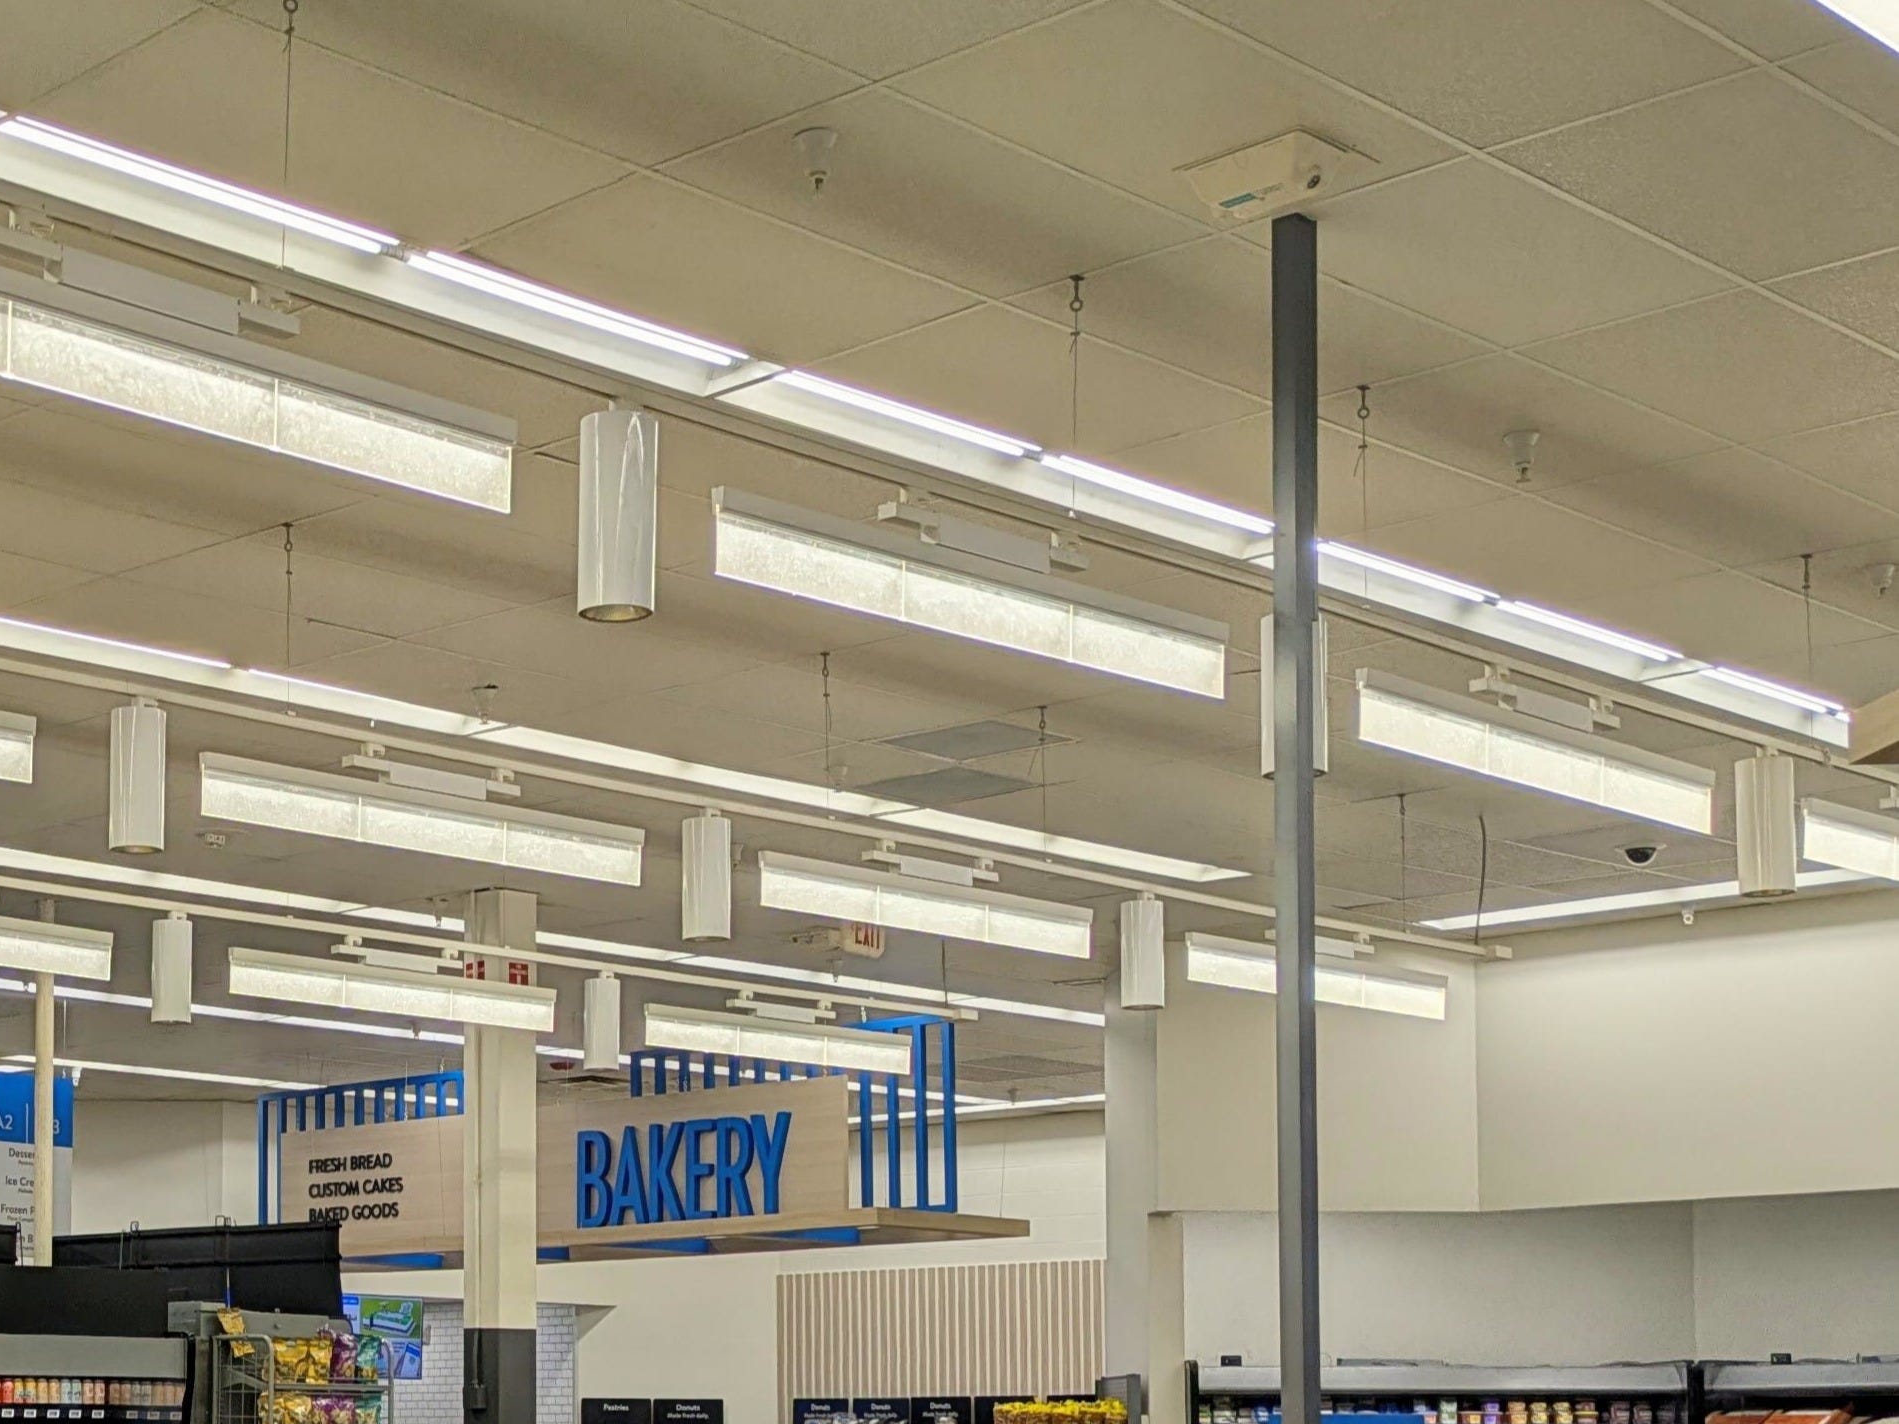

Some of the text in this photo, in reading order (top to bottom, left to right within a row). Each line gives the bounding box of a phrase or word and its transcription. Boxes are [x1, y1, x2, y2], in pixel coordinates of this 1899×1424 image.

[308, 1152, 393, 1174] FRESH BREAD
[576, 1111, 792, 1229] BAKERY
[308, 1177, 404, 1198] CUSTOM CAKES
[309, 1202, 400, 1222] BAKED GOODS
[603, 1404, 630, 1412] Pastries
[676, 1404, 700, 1412] Donuts
